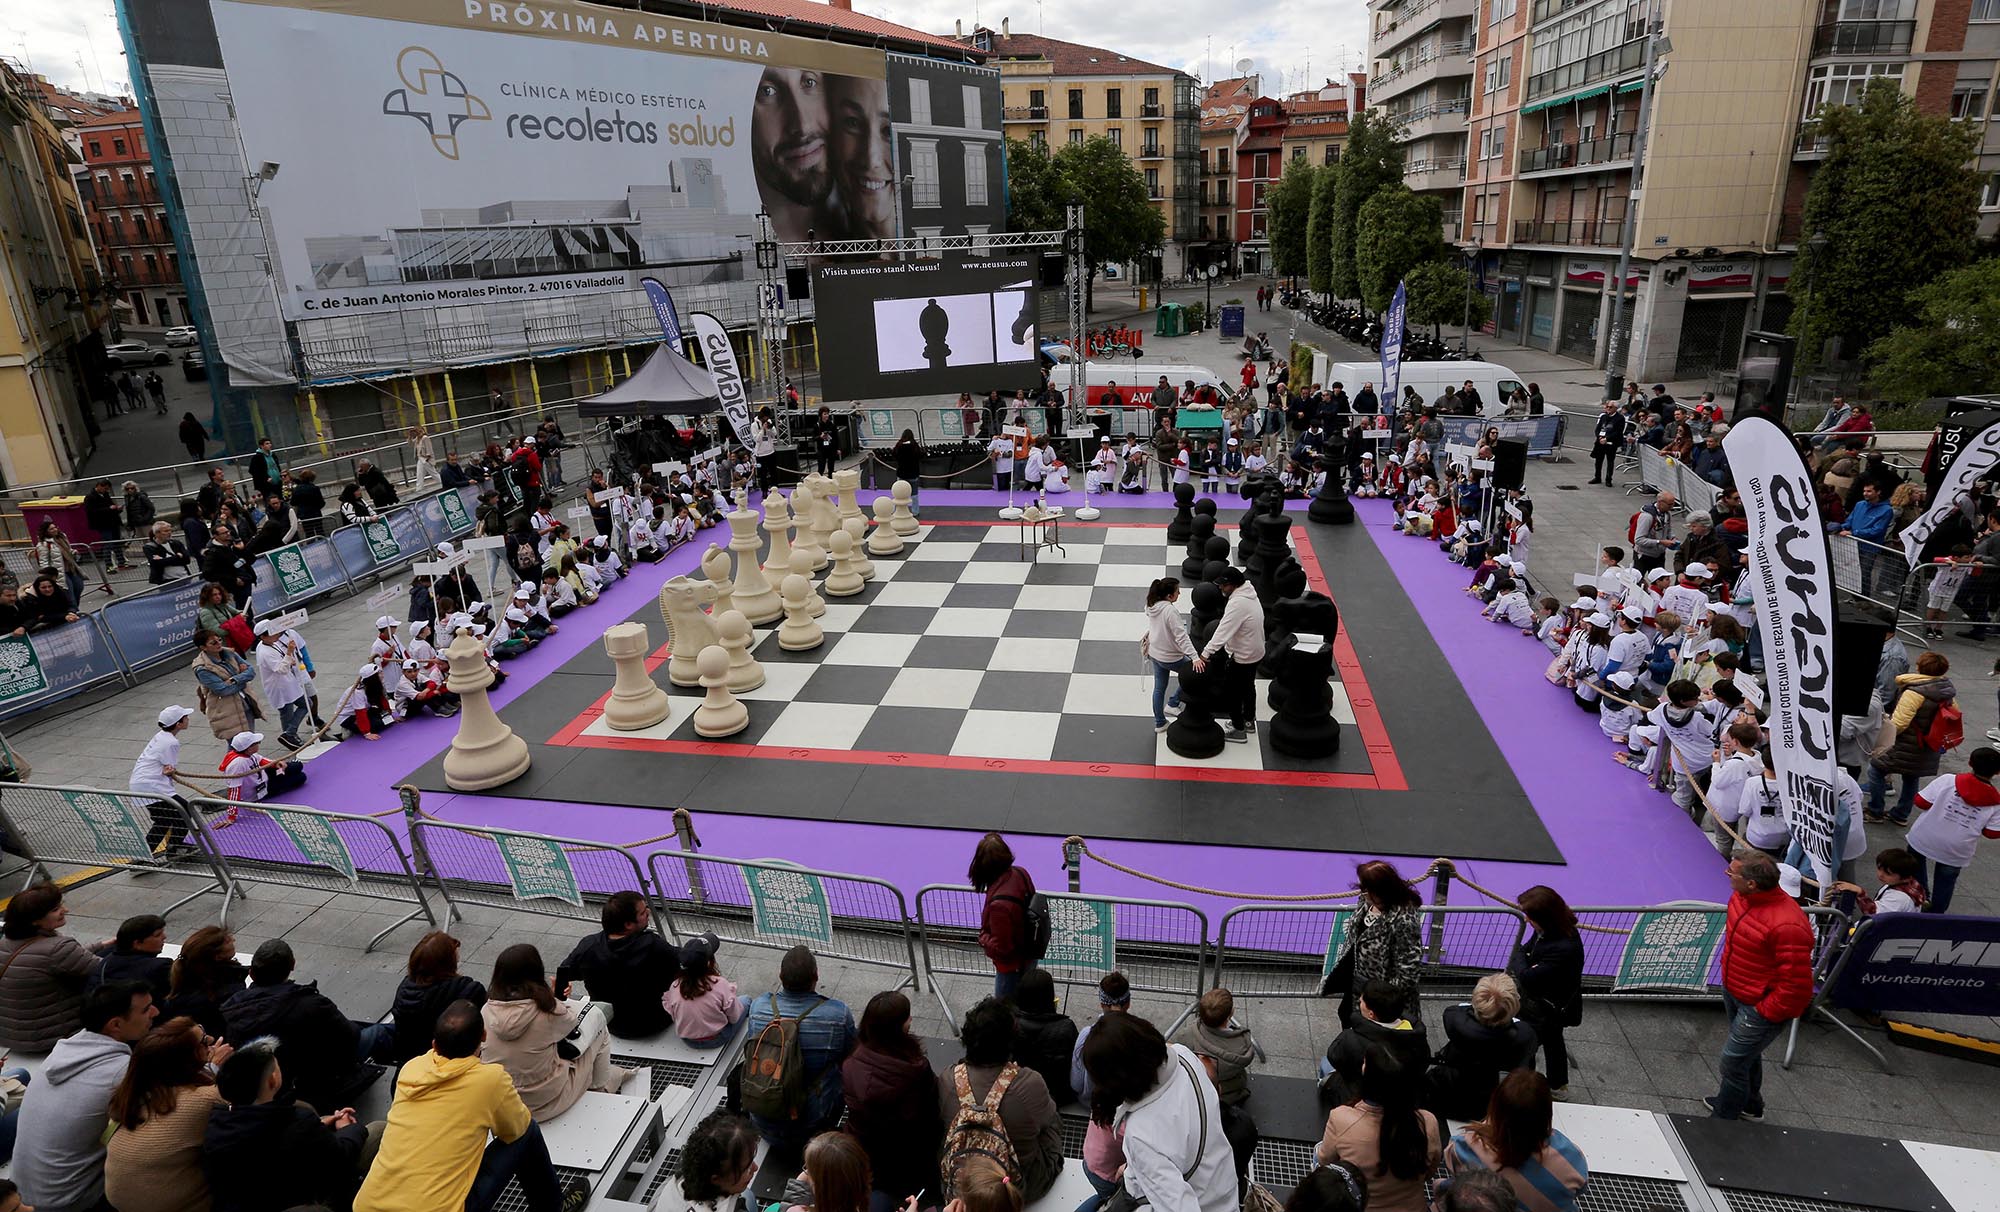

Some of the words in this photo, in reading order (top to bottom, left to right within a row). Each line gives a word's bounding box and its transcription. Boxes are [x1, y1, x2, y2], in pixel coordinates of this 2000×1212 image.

[465, 0, 619, 38] PRÓXIMA
[633, 24, 769, 57] APERTURA
[500, 82, 569, 101] CLÍNICA
[576, 88, 635, 105] MÉDICO
[641, 94, 706, 111] ESTÉTICA
[506, 107, 658, 144] recoletas
[667, 114, 735, 147] salud
[821, 266, 848, 278] ¡Visita
[850, 266, 881, 276] nuestro
[883, 264, 906, 273] stand
[907, 263, 941, 272] Neusus!
[961, 259, 1028, 270] www.neusus.com
[304, 299, 319, 311] C.
[321, 297, 340, 309] de
[342, 295, 379, 308] Juan
[381, 290, 435, 304] Antonio
[437, 286, 486, 300] Morales
[488, 283, 527, 297] Pintor,
[528, 282, 539, 293] 2.
[540, 279, 573, 292] 47016
[574, 275, 625, 289] Valladolid
[1861, 972, 1985, 988] Ayuntamiento
